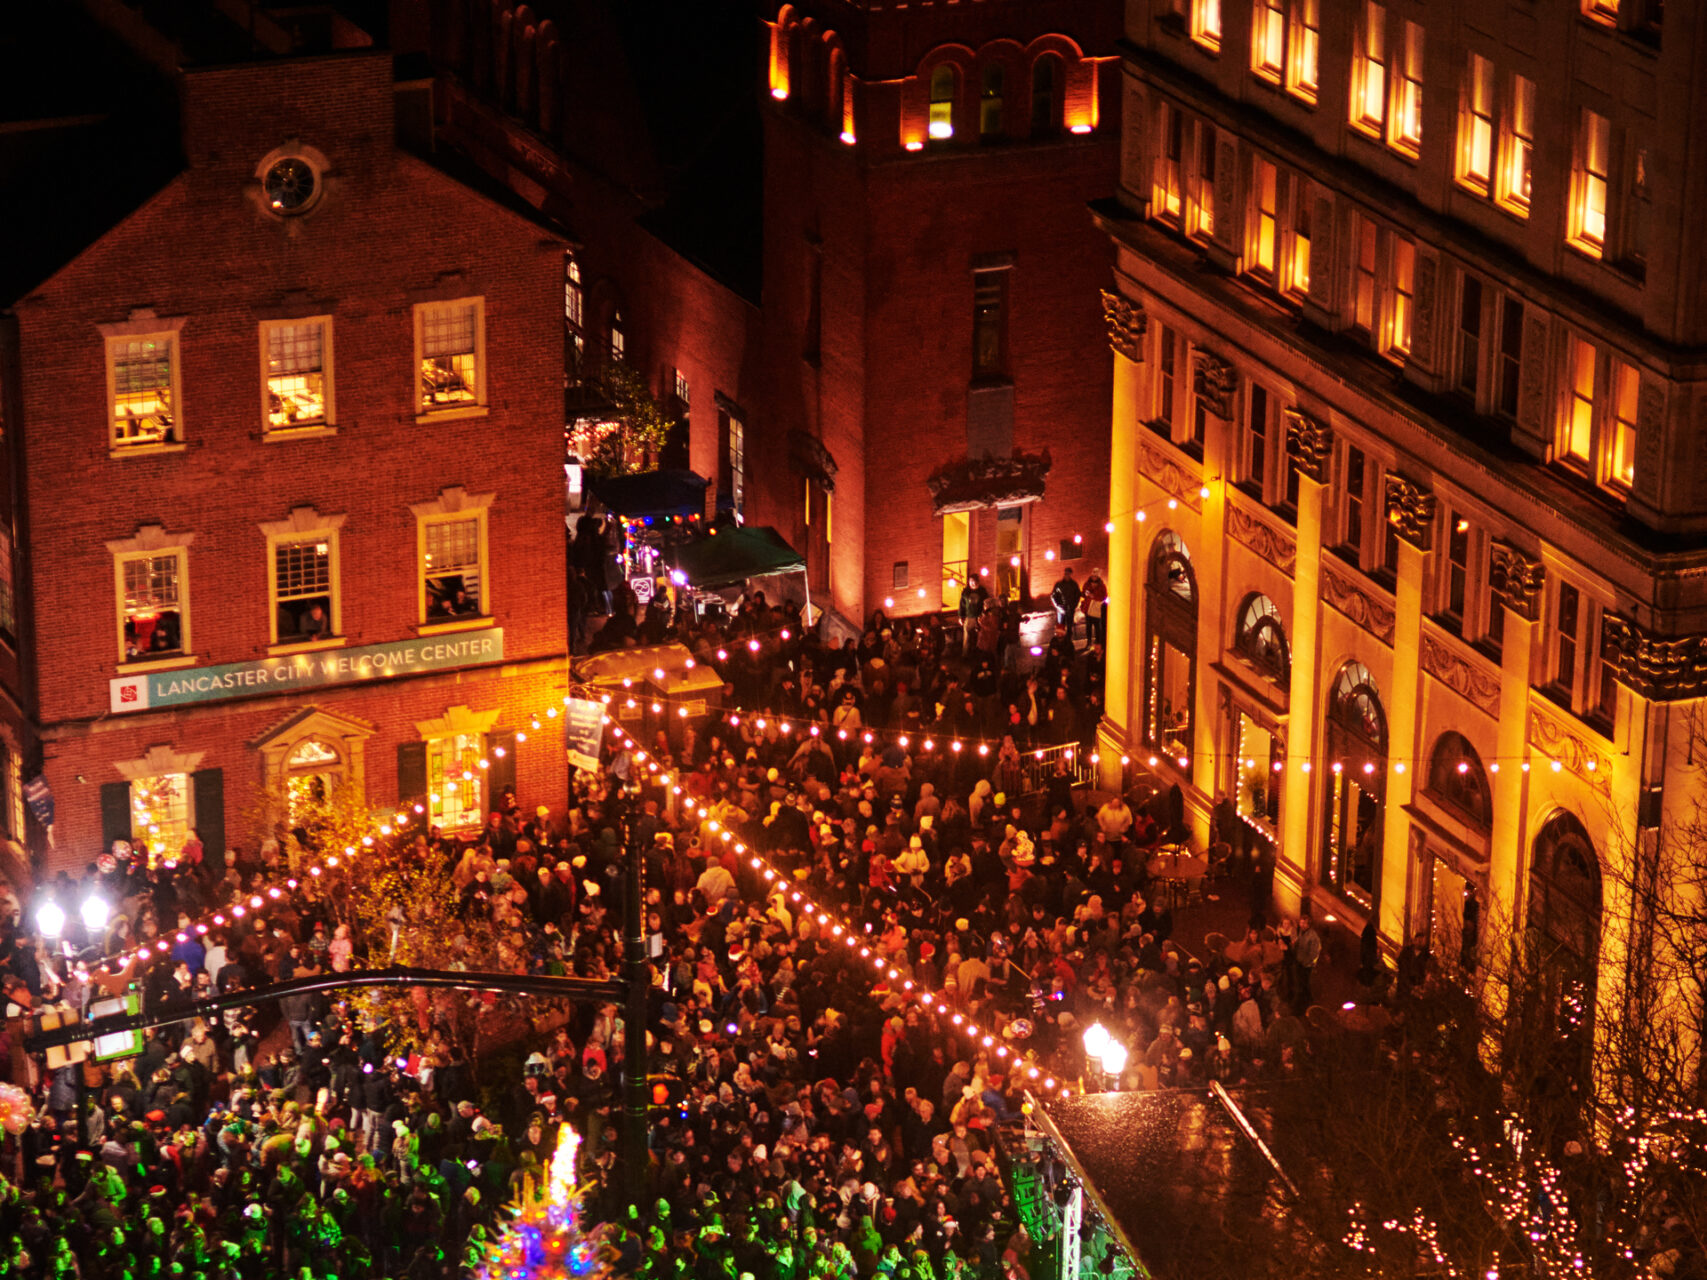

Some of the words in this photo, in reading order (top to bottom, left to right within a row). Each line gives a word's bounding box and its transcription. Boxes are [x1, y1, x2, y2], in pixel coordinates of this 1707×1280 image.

[157, 669, 268, 697] LANCASTER
[274, 662, 315, 682] CITY
[321, 649, 415, 675] WELCOME
[421, 639, 492, 661] CENTER
